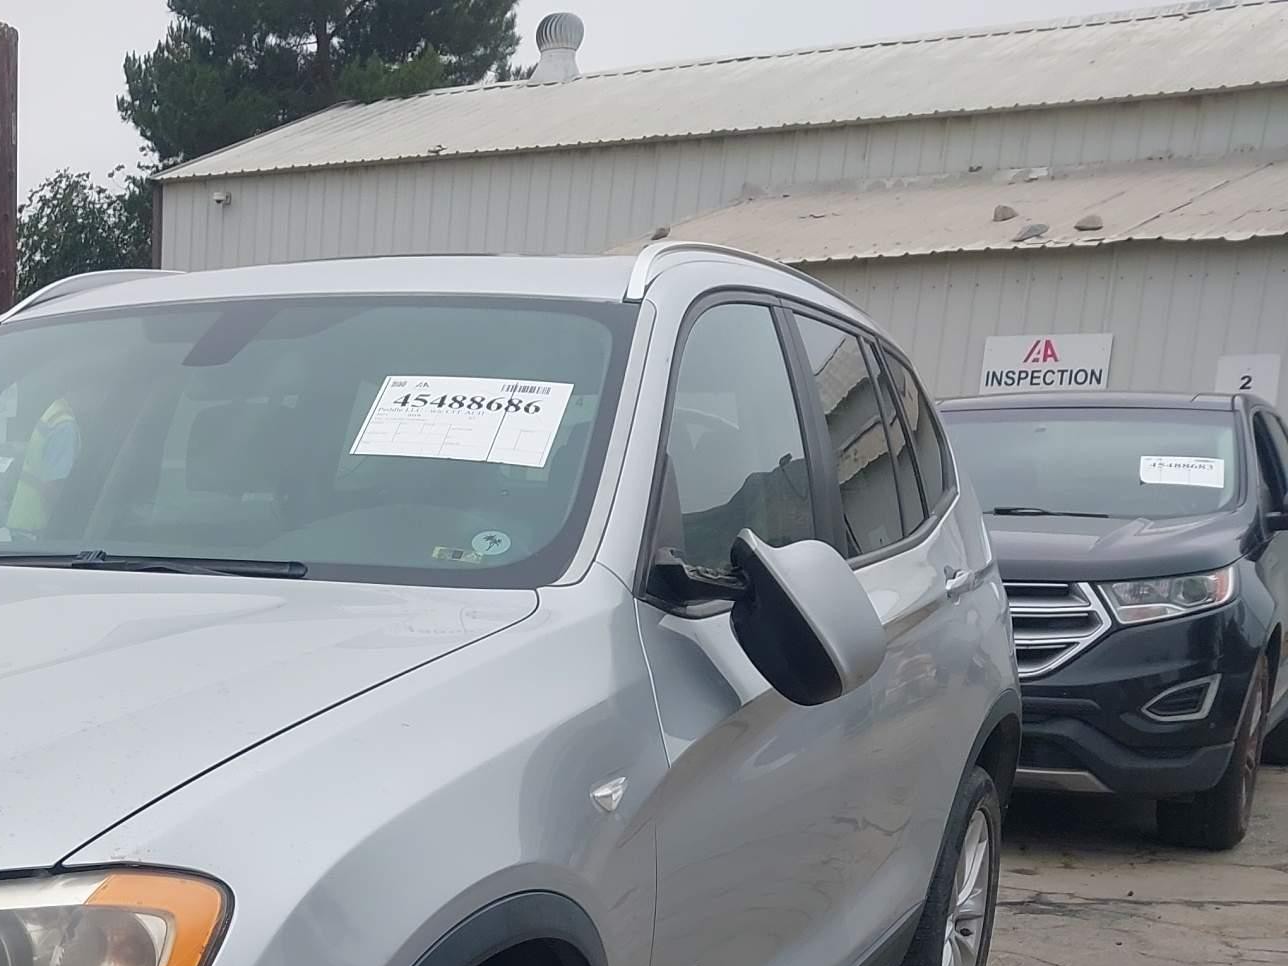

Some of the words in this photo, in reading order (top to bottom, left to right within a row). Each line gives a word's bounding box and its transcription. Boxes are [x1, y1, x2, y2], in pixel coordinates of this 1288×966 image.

[985, 368, 1103, 387] INSPECTION
[1240, 375, 1252, 390] 2
[393, 393, 544, 415] 45488686
